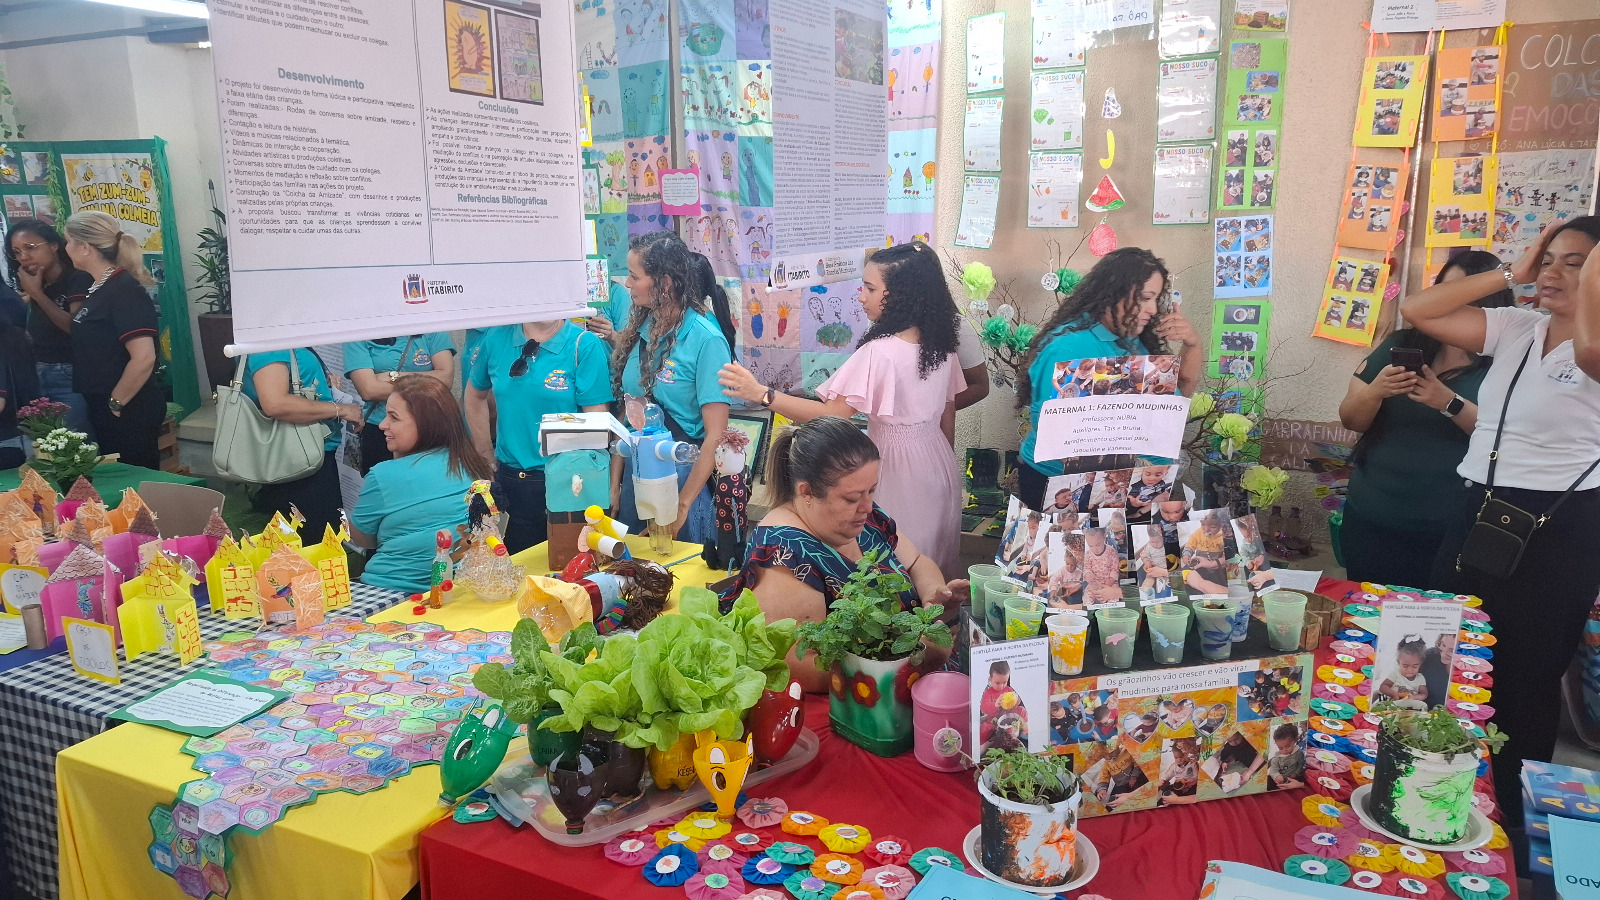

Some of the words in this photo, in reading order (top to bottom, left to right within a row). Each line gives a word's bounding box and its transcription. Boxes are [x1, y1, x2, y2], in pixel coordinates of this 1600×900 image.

[1170, 62, 1190, 70] NOSSO
[277, 67, 365, 90] Desenvolvimento
[1060, 73, 1075, 81] SUCO
[478, 101, 519, 115] Conclusões
[1516, 140, 1538, 150] ANA
[1541, 138, 1566, 149] LÚCIA
[77, 183, 99, 204] TEM
[457, 193, 500, 204] Referências
[502, 195, 548, 206] Bibliográficas
[118, 202, 159, 227] COLMEIA
[787, 270, 810, 281] ITABIRITO
[428, 285, 464, 296] ITABIRITO
[1044, 405, 1087, 415] MATERNAL
[1096, 402, 1134, 411] FAZENDO
[1136, 403, 1183, 412] MUDINHAS
[1116, 413, 1137, 421] NÚBIA
[1064, 437, 1108, 445] Agradecimento
[1289, 442, 1310, 456] DA
[1106, 678, 1117, 686] Os
[1118, 675, 1161, 687] grãozinhos
[1178, 670, 1206, 679] crescer
[1214, 666, 1228, 674] vão
[1121, 686, 1160, 696] mudinhas
[1161, 685, 1179, 694] para
[1181, 681, 1203, 690] nossa
